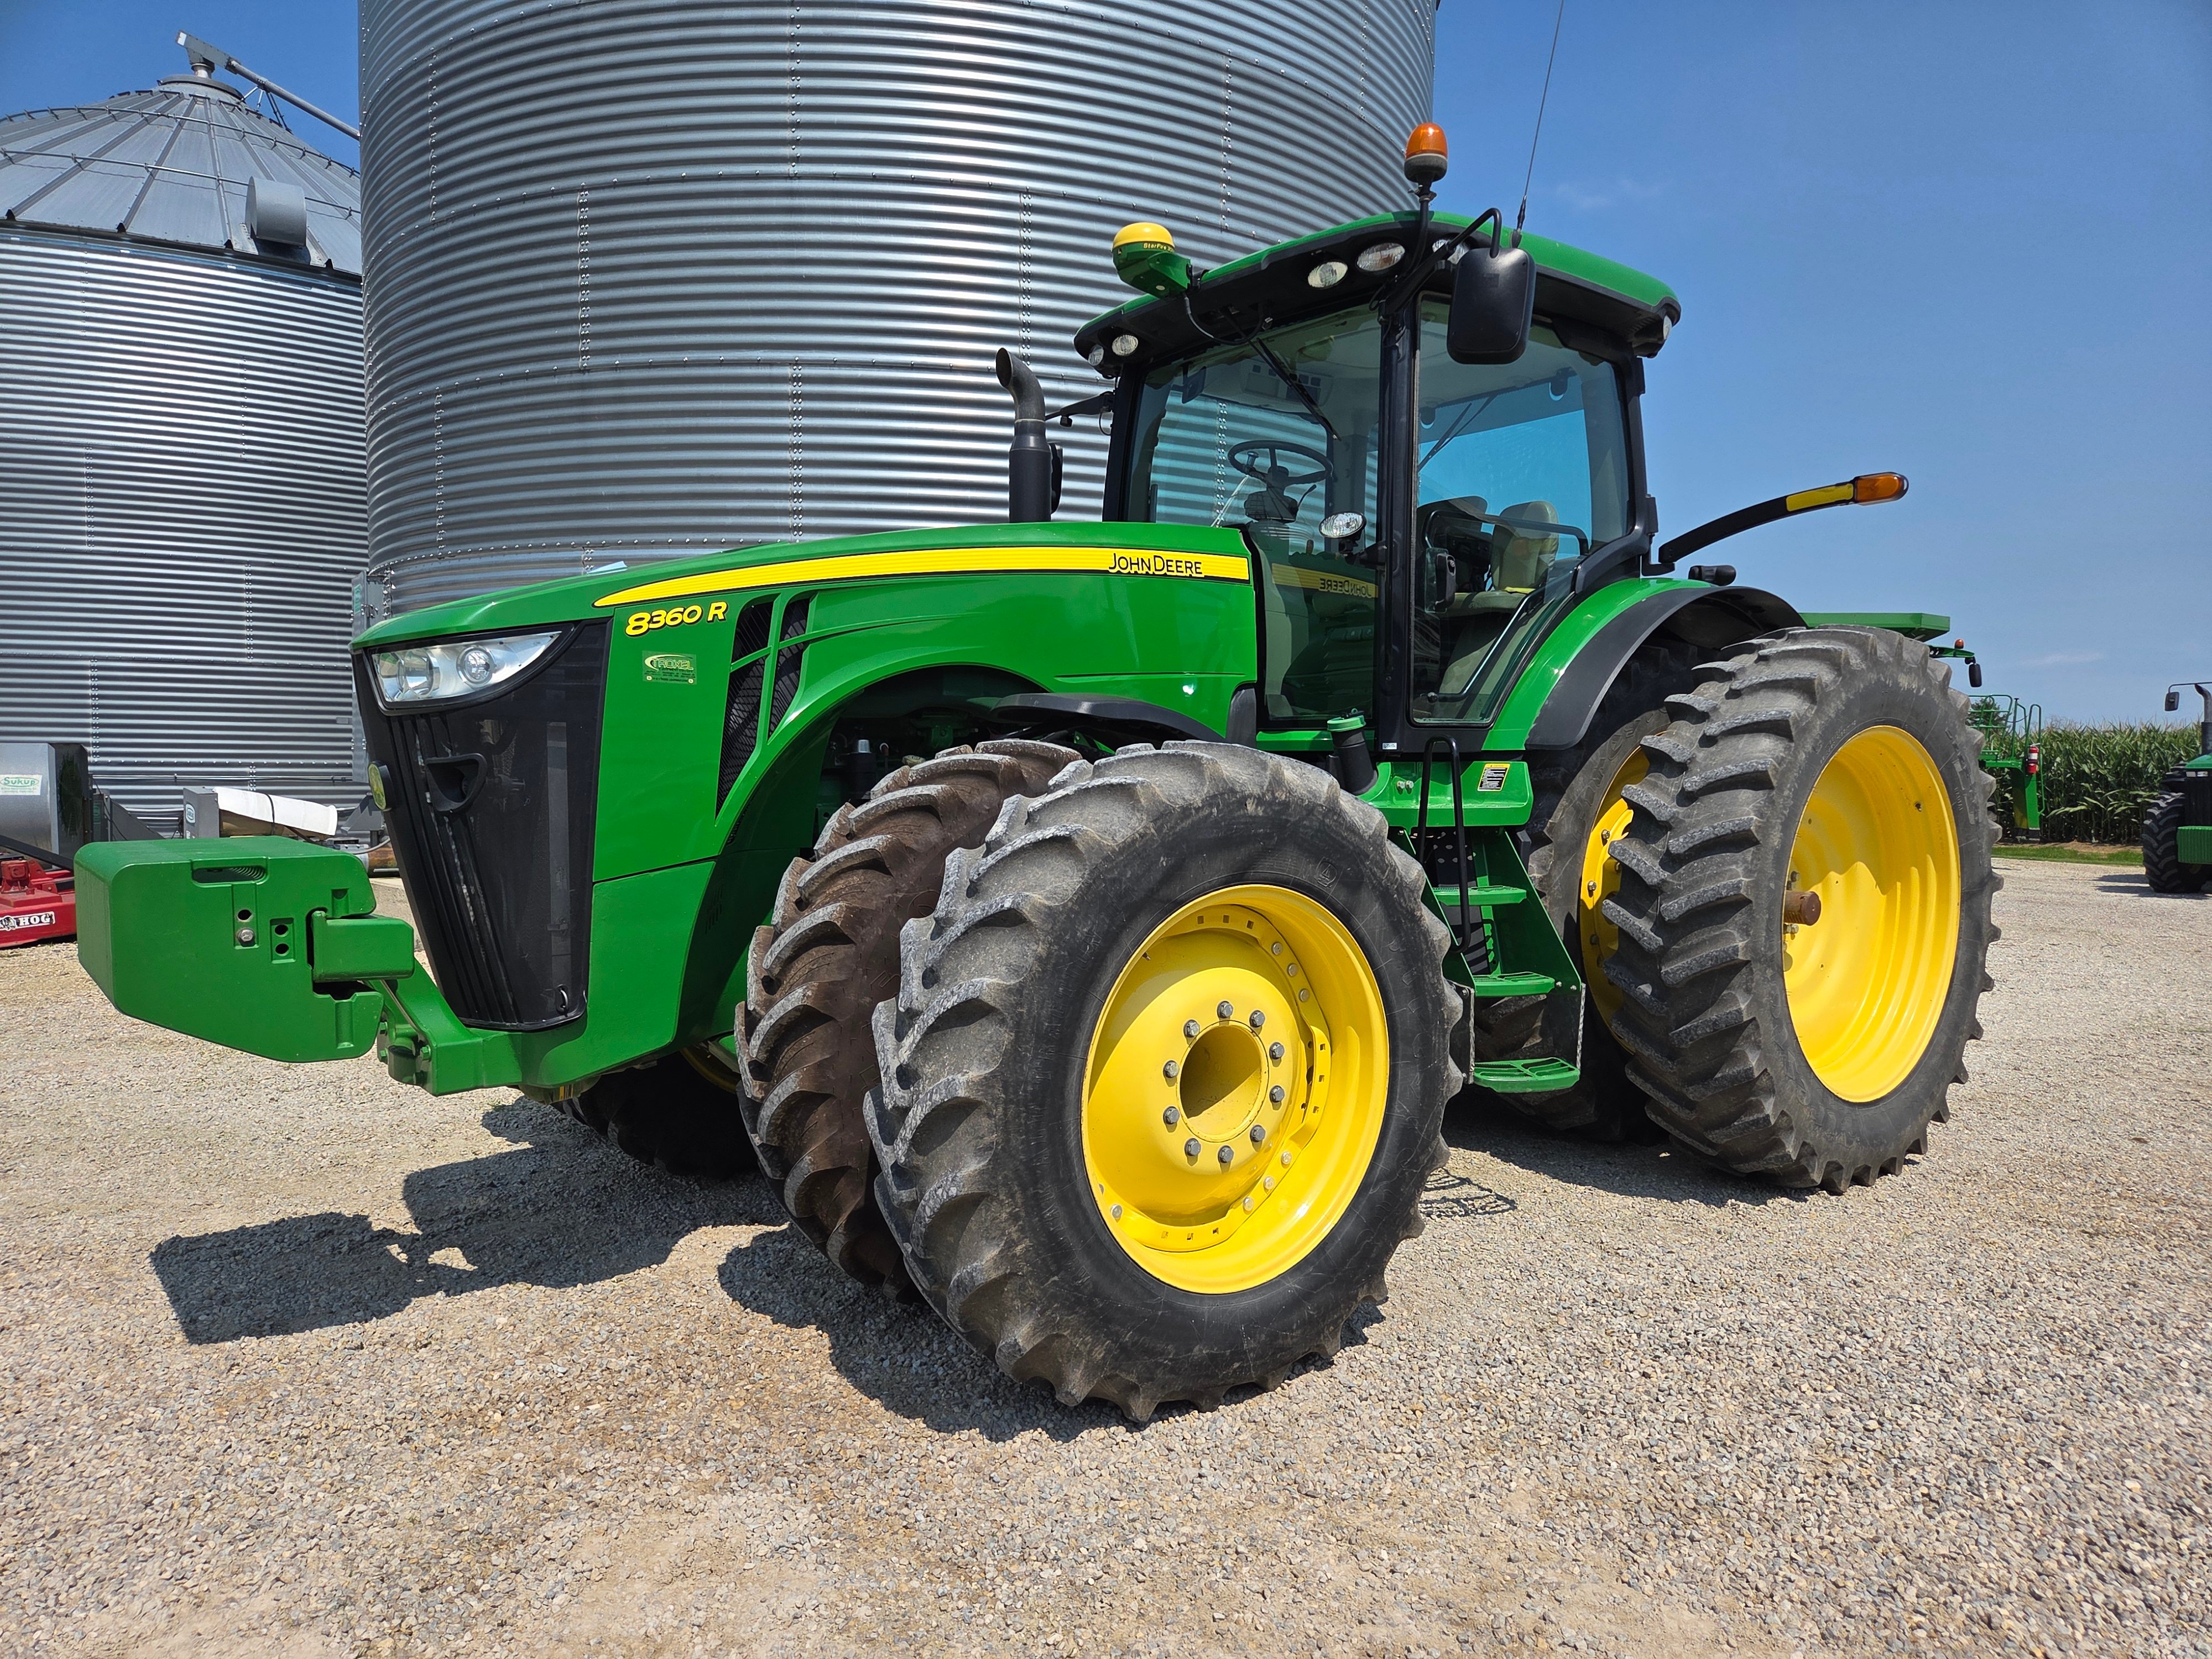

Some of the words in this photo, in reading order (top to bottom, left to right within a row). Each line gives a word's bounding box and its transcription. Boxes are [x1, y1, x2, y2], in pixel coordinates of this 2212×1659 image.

[1109, 553, 1151, 571] JOHN
[1154, 555, 1203, 575] DEERE
[625, 604, 702, 637] 8360
[707, 601, 728, 623] R
[652, 658, 694, 670] TROXEL
[18, 914, 51, 926] HOG
